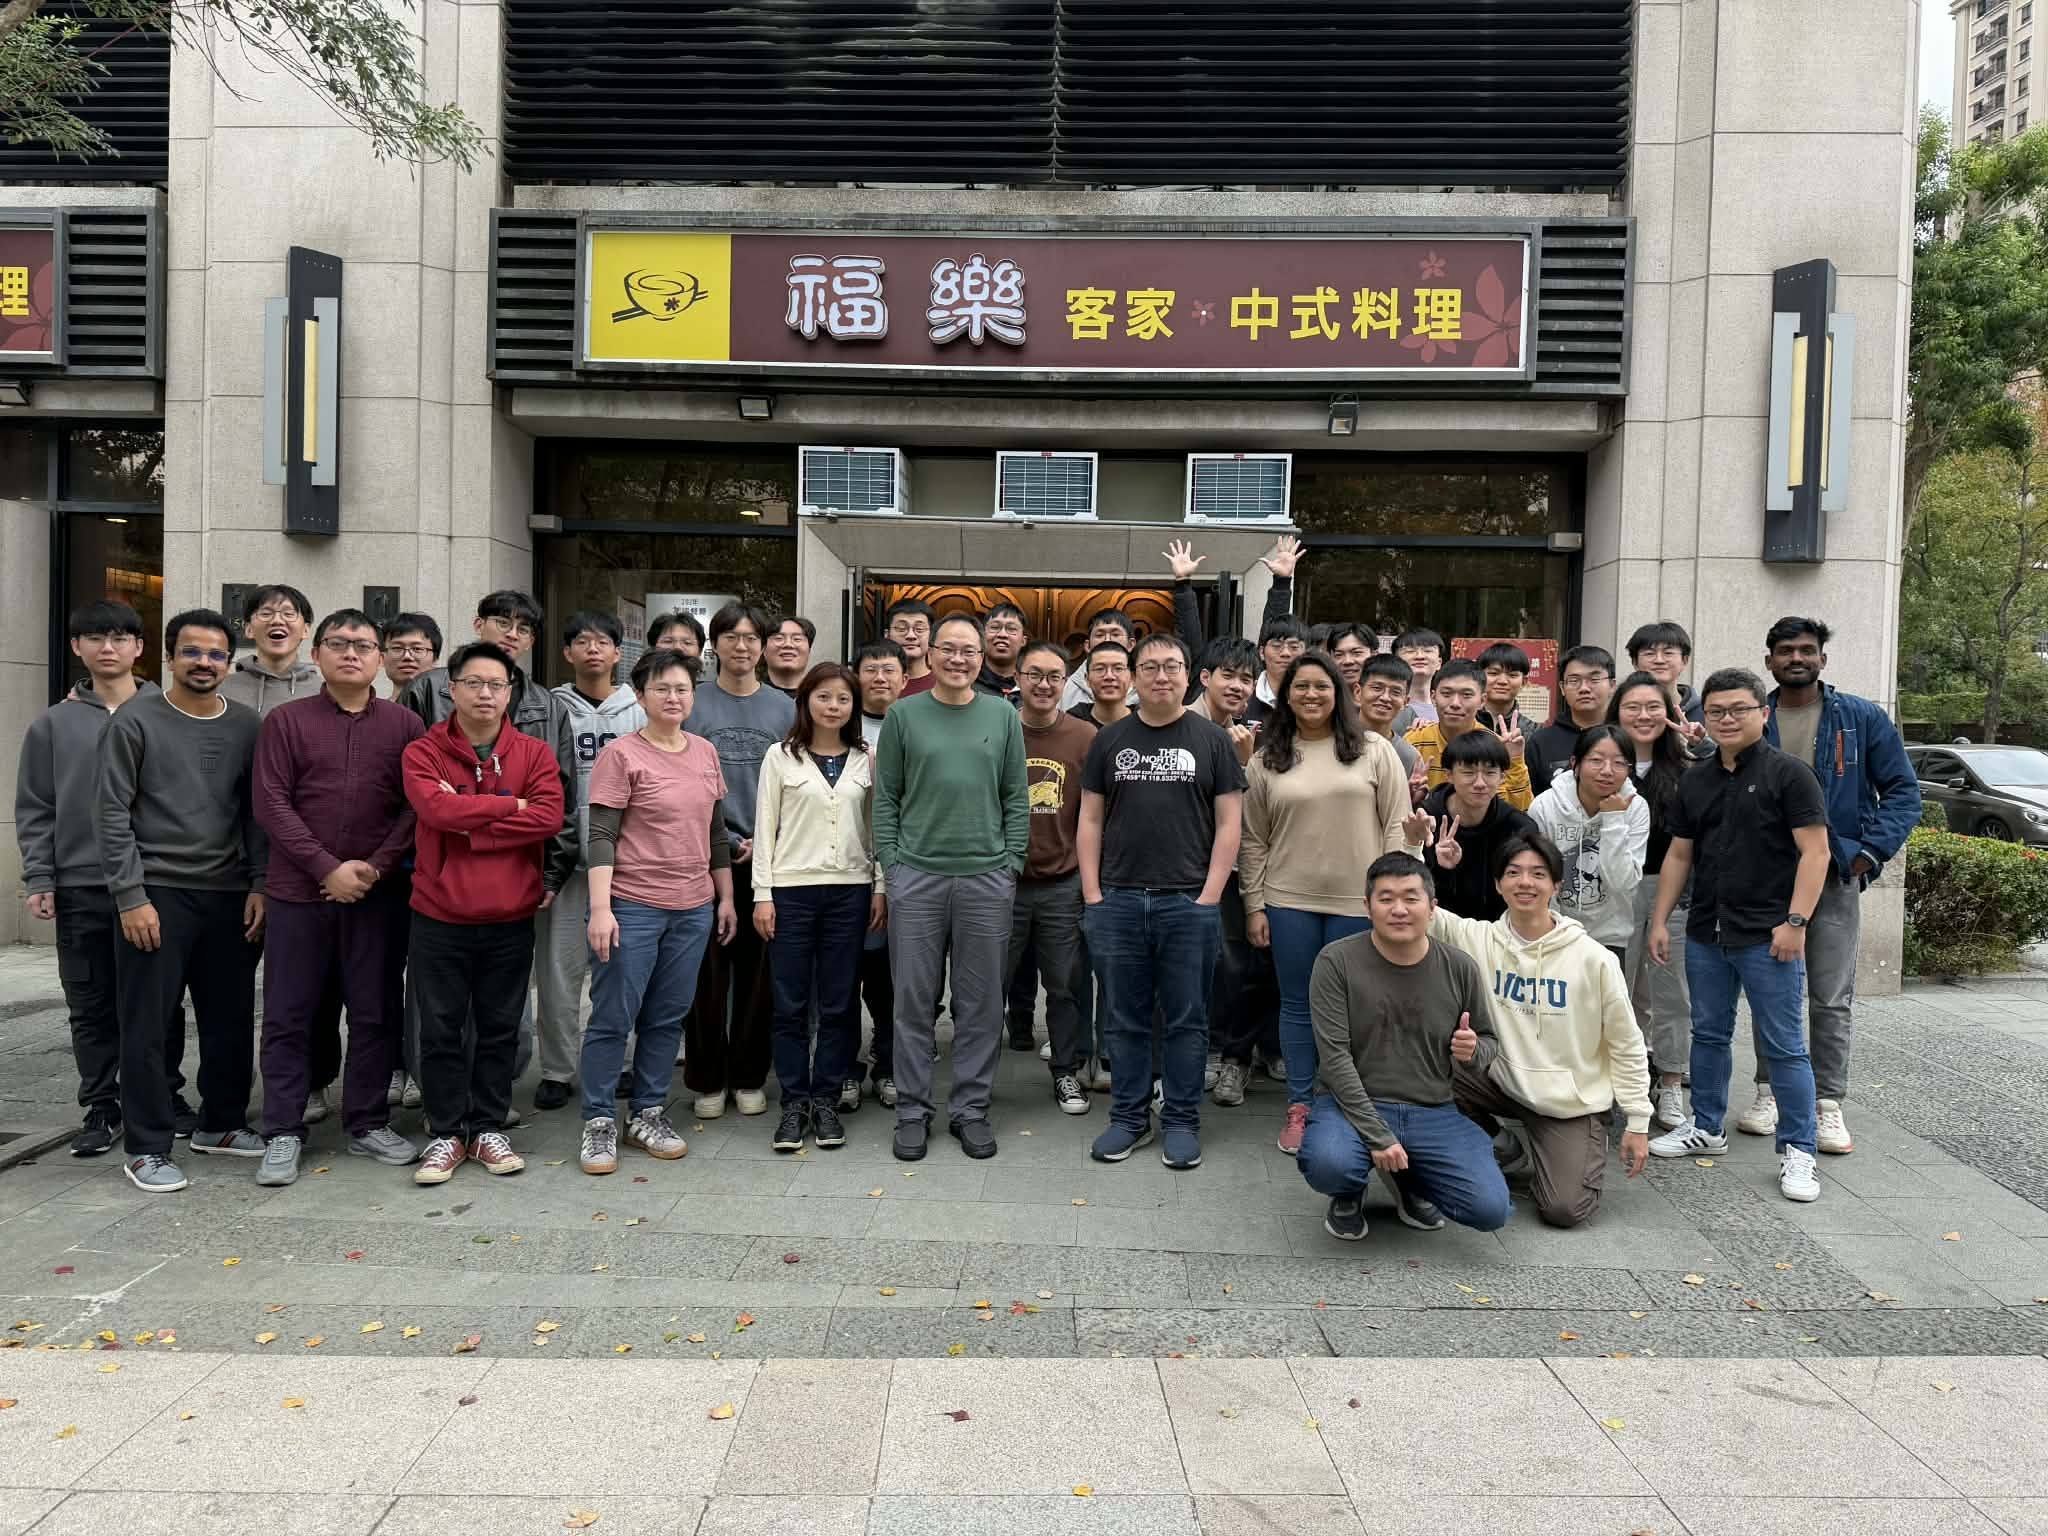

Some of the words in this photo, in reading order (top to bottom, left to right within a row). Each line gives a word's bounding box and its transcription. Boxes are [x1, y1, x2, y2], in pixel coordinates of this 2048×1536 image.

[786, 253, 1026, 345] 福樂
[1065, 286, 1176, 341] 客家
[1230, 286, 1463, 341] 中式料理
[1158, 748, 1178, 757] THE
[1141, 755, 1178, 763] NORTH
[1151, 762, 1178, 771] FACE
